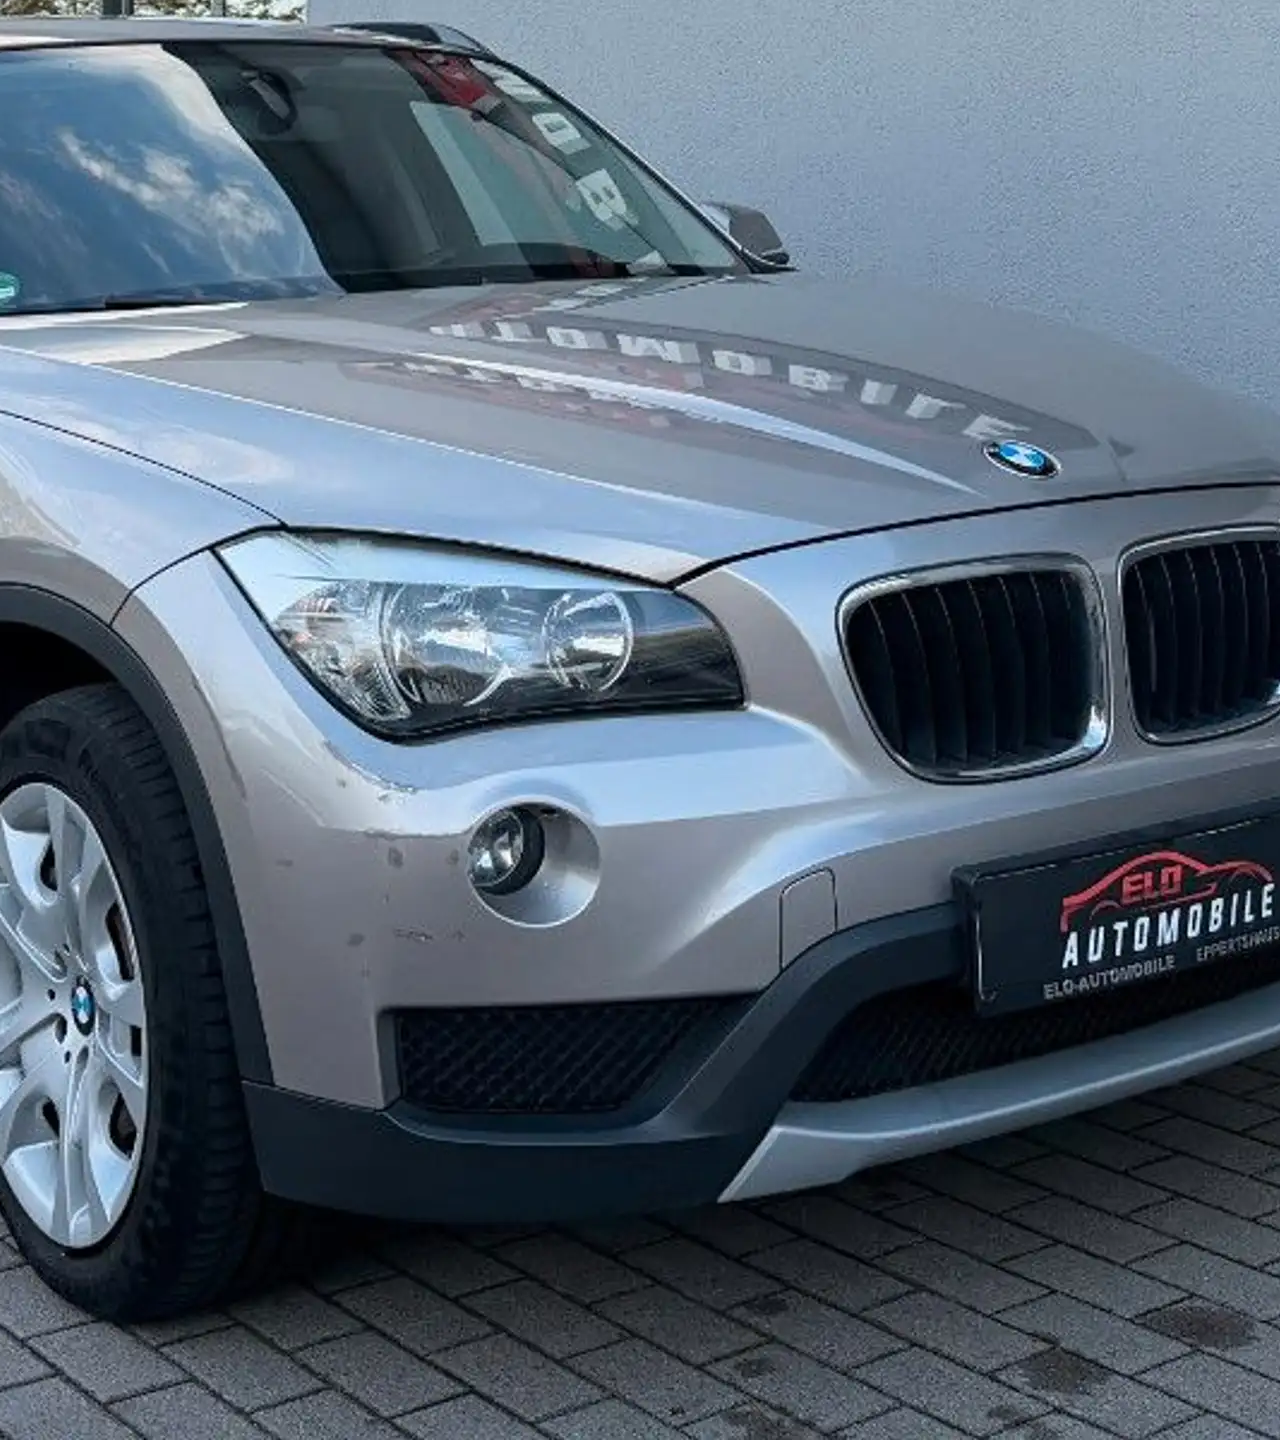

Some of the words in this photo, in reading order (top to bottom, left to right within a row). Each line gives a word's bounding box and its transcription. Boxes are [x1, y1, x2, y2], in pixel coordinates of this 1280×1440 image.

[1121, 863, 1183, 904] ELO
[1062, 882, 1276, 969] AUTOMOBILE
[1043, 954, 1175, 1000] ELO-AUTOMOBILE
